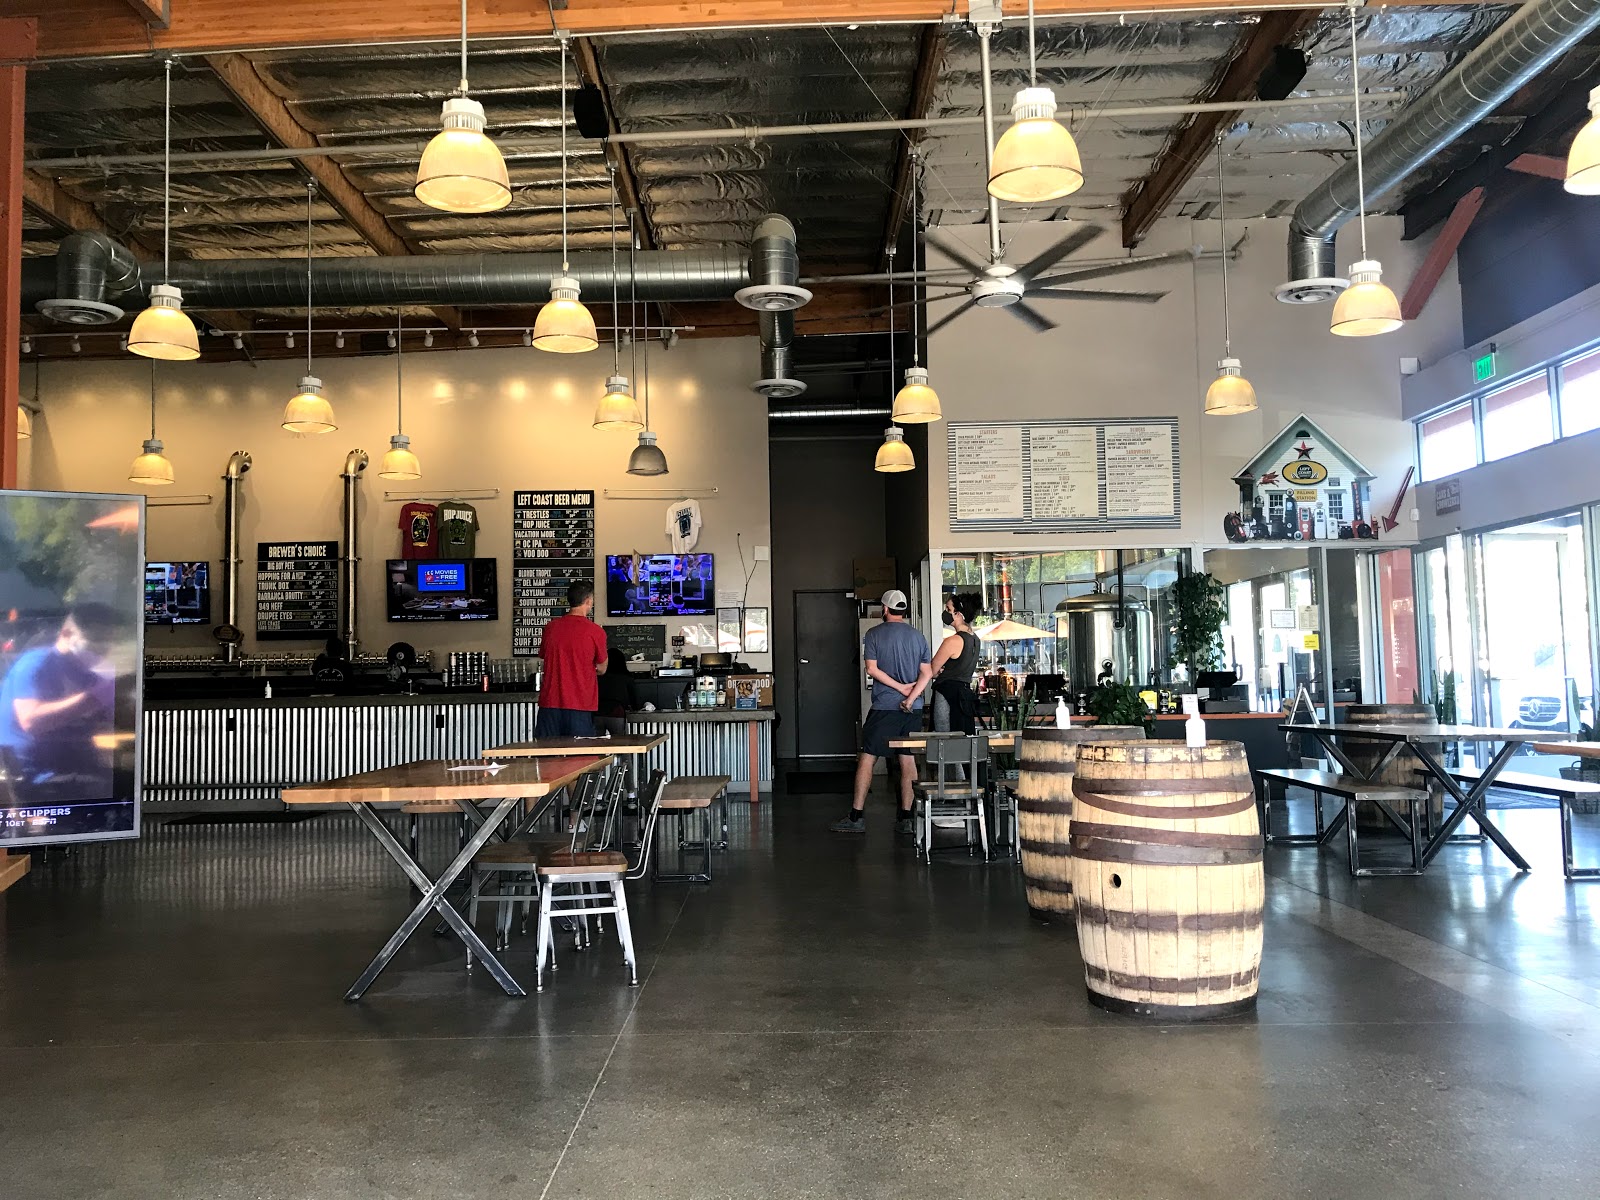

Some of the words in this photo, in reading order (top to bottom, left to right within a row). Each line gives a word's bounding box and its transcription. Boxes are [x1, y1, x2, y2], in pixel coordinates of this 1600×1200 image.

[517, 494, 531, 505] LEFT
[532, 494, 553, 506] COAST
[554, 493, 570, 505] BEER
[571, 493, 590, 505] MENU
[443, 509, 456, 521] HOP
[456, 509, 473, 523] JUICE
[522, 510, 549, 519] TRESTLES
[522, 520, 534, 529] HOP
[535, 520, 550, 529] JUICE
[514, 530, 539, 538] VACATION
[540, 530, 556, 538] MODE
[522, 539, 531, 548] OC
[532, 539, 542, 548] IPA
[268, 543, 302, 558] BREWER'S
[303, 545, 327, 557] CHOICE
[523, 549, 535, 558] VOO
[536, 549, 549, 558] DOO
[267, 562, 275, 571] BIG
[275, 562, 284, 570] BOY
[284, 561, 295, 570] PETE
[257, 572, 280, 581] HOPPING
[280, 572, 291, 580] FOR
[518, 569, 535, 578] BLONDE
[258, 582, 277, 591] TRUNK
[278, 581, 289, 590] BOX
[522, 579, 532, 587] DEL
[532, 579, 545, 587] MAR
[257, 592, 284, 601] BARRANCA
[521, 588, 545, 597] ASYLUM
[258, 602, 270, 611] 949
[519, 598, 537, 607] SOUTH
[537, 598, 558, 606] COUNTY
[257, 611, 279, 620] DRUPEE
[279, 611, 293, 620] EYES
[522, 608, 535, 617] UNA
[536, 608, 551, 617] MAS
[522, 617, 547, 626] NUCLEAR
[513, 637, 531, 646] SURF
[513, 647, 531, 655] BARREL
[756, 678, 770, 688] OOD
[19, 808, 71, 818] CLIPPERS
